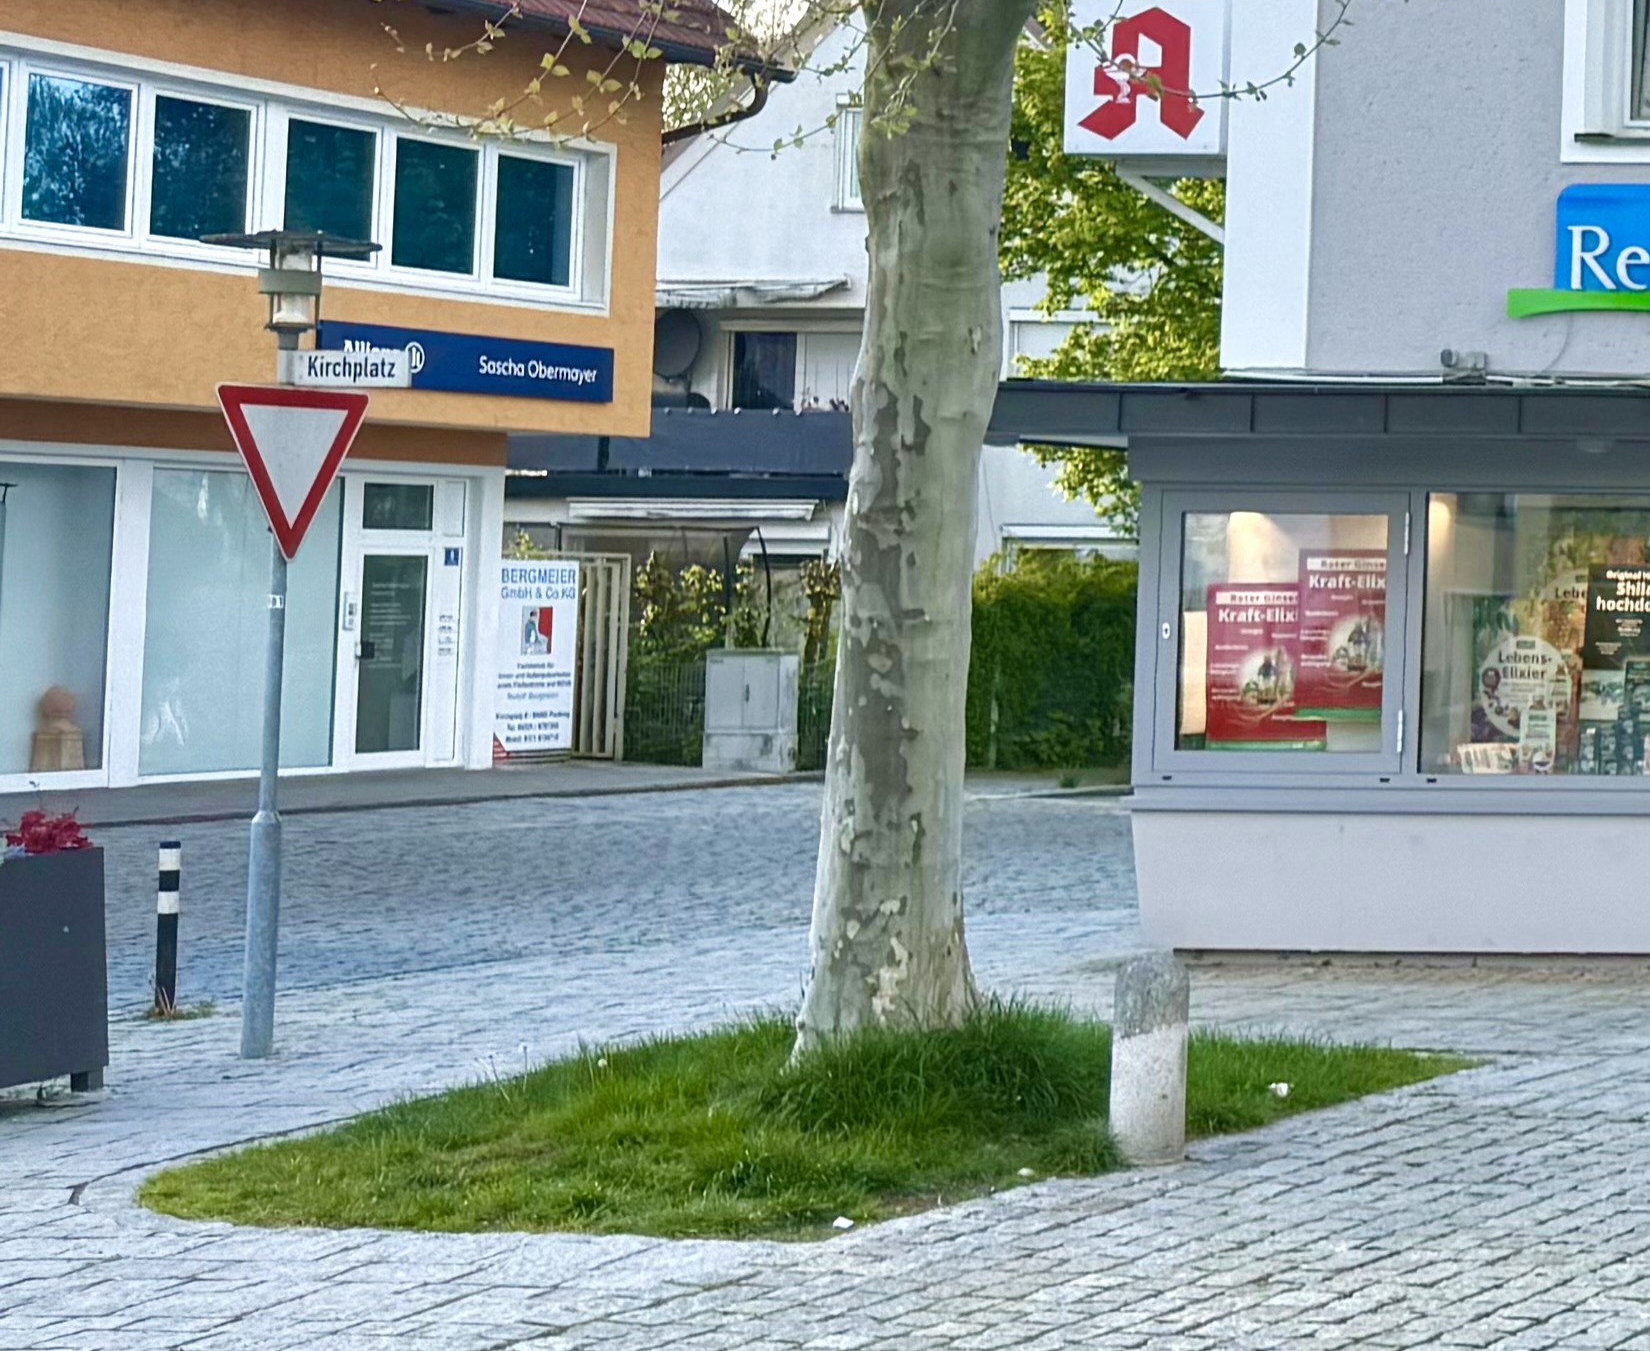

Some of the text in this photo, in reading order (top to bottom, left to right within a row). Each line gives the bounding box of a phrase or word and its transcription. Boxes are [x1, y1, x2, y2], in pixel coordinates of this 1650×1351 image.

[307, 355, 396, 383] Kirchplatz
[479, 355, 598, 386] Sascha Obermayer
[501, 567, 577, 585] BERGMEIER
